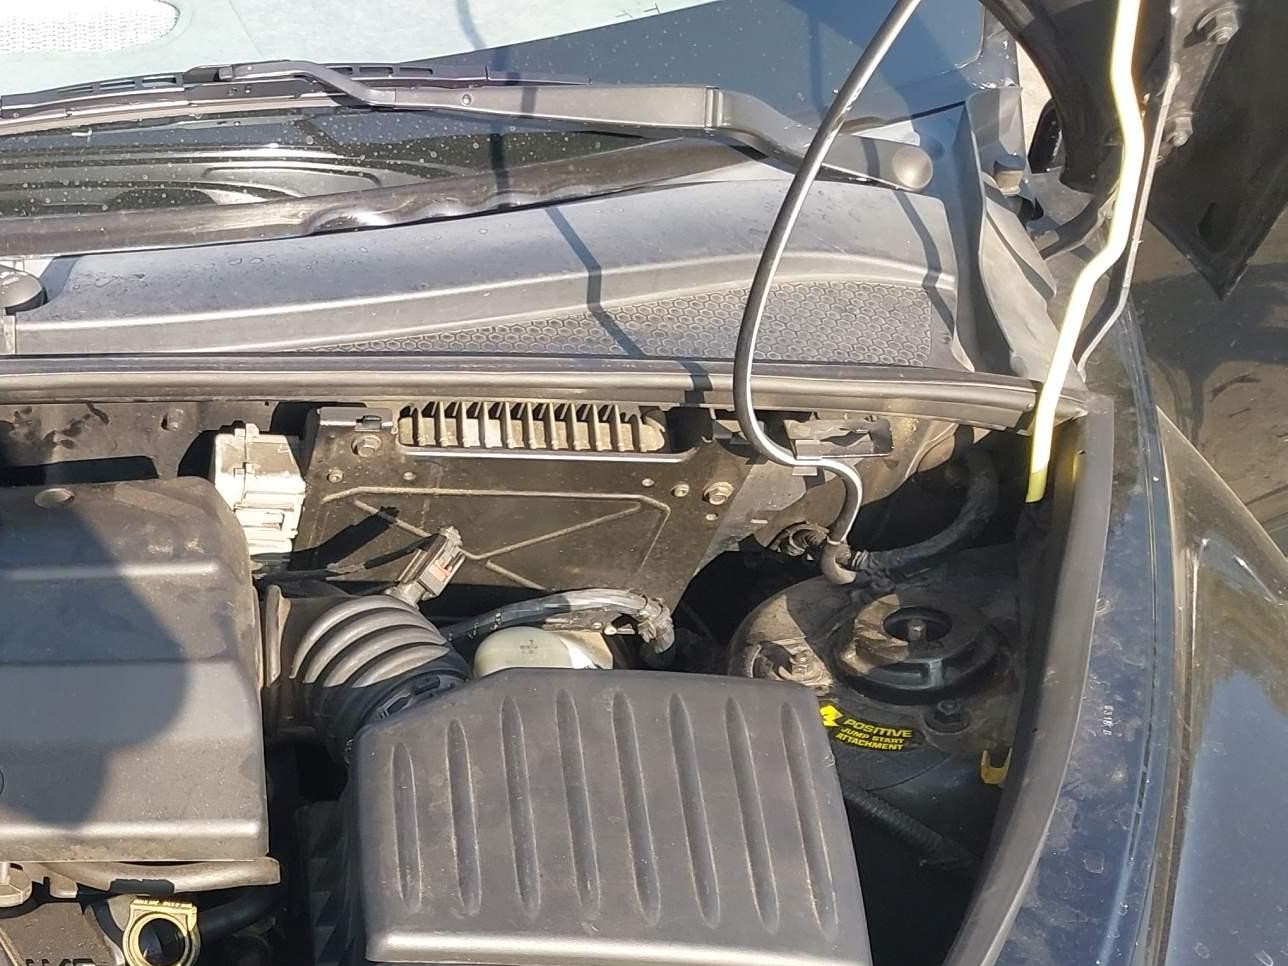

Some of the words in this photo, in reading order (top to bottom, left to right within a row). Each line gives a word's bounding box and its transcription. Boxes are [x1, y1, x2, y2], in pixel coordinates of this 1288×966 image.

[840, 727, 870, 739] JUMP
[871, 736, 905, 744] START
[843, 718, 913, 738] POSITIVE
[835, 732, 904, 751] ATTACHMENT
